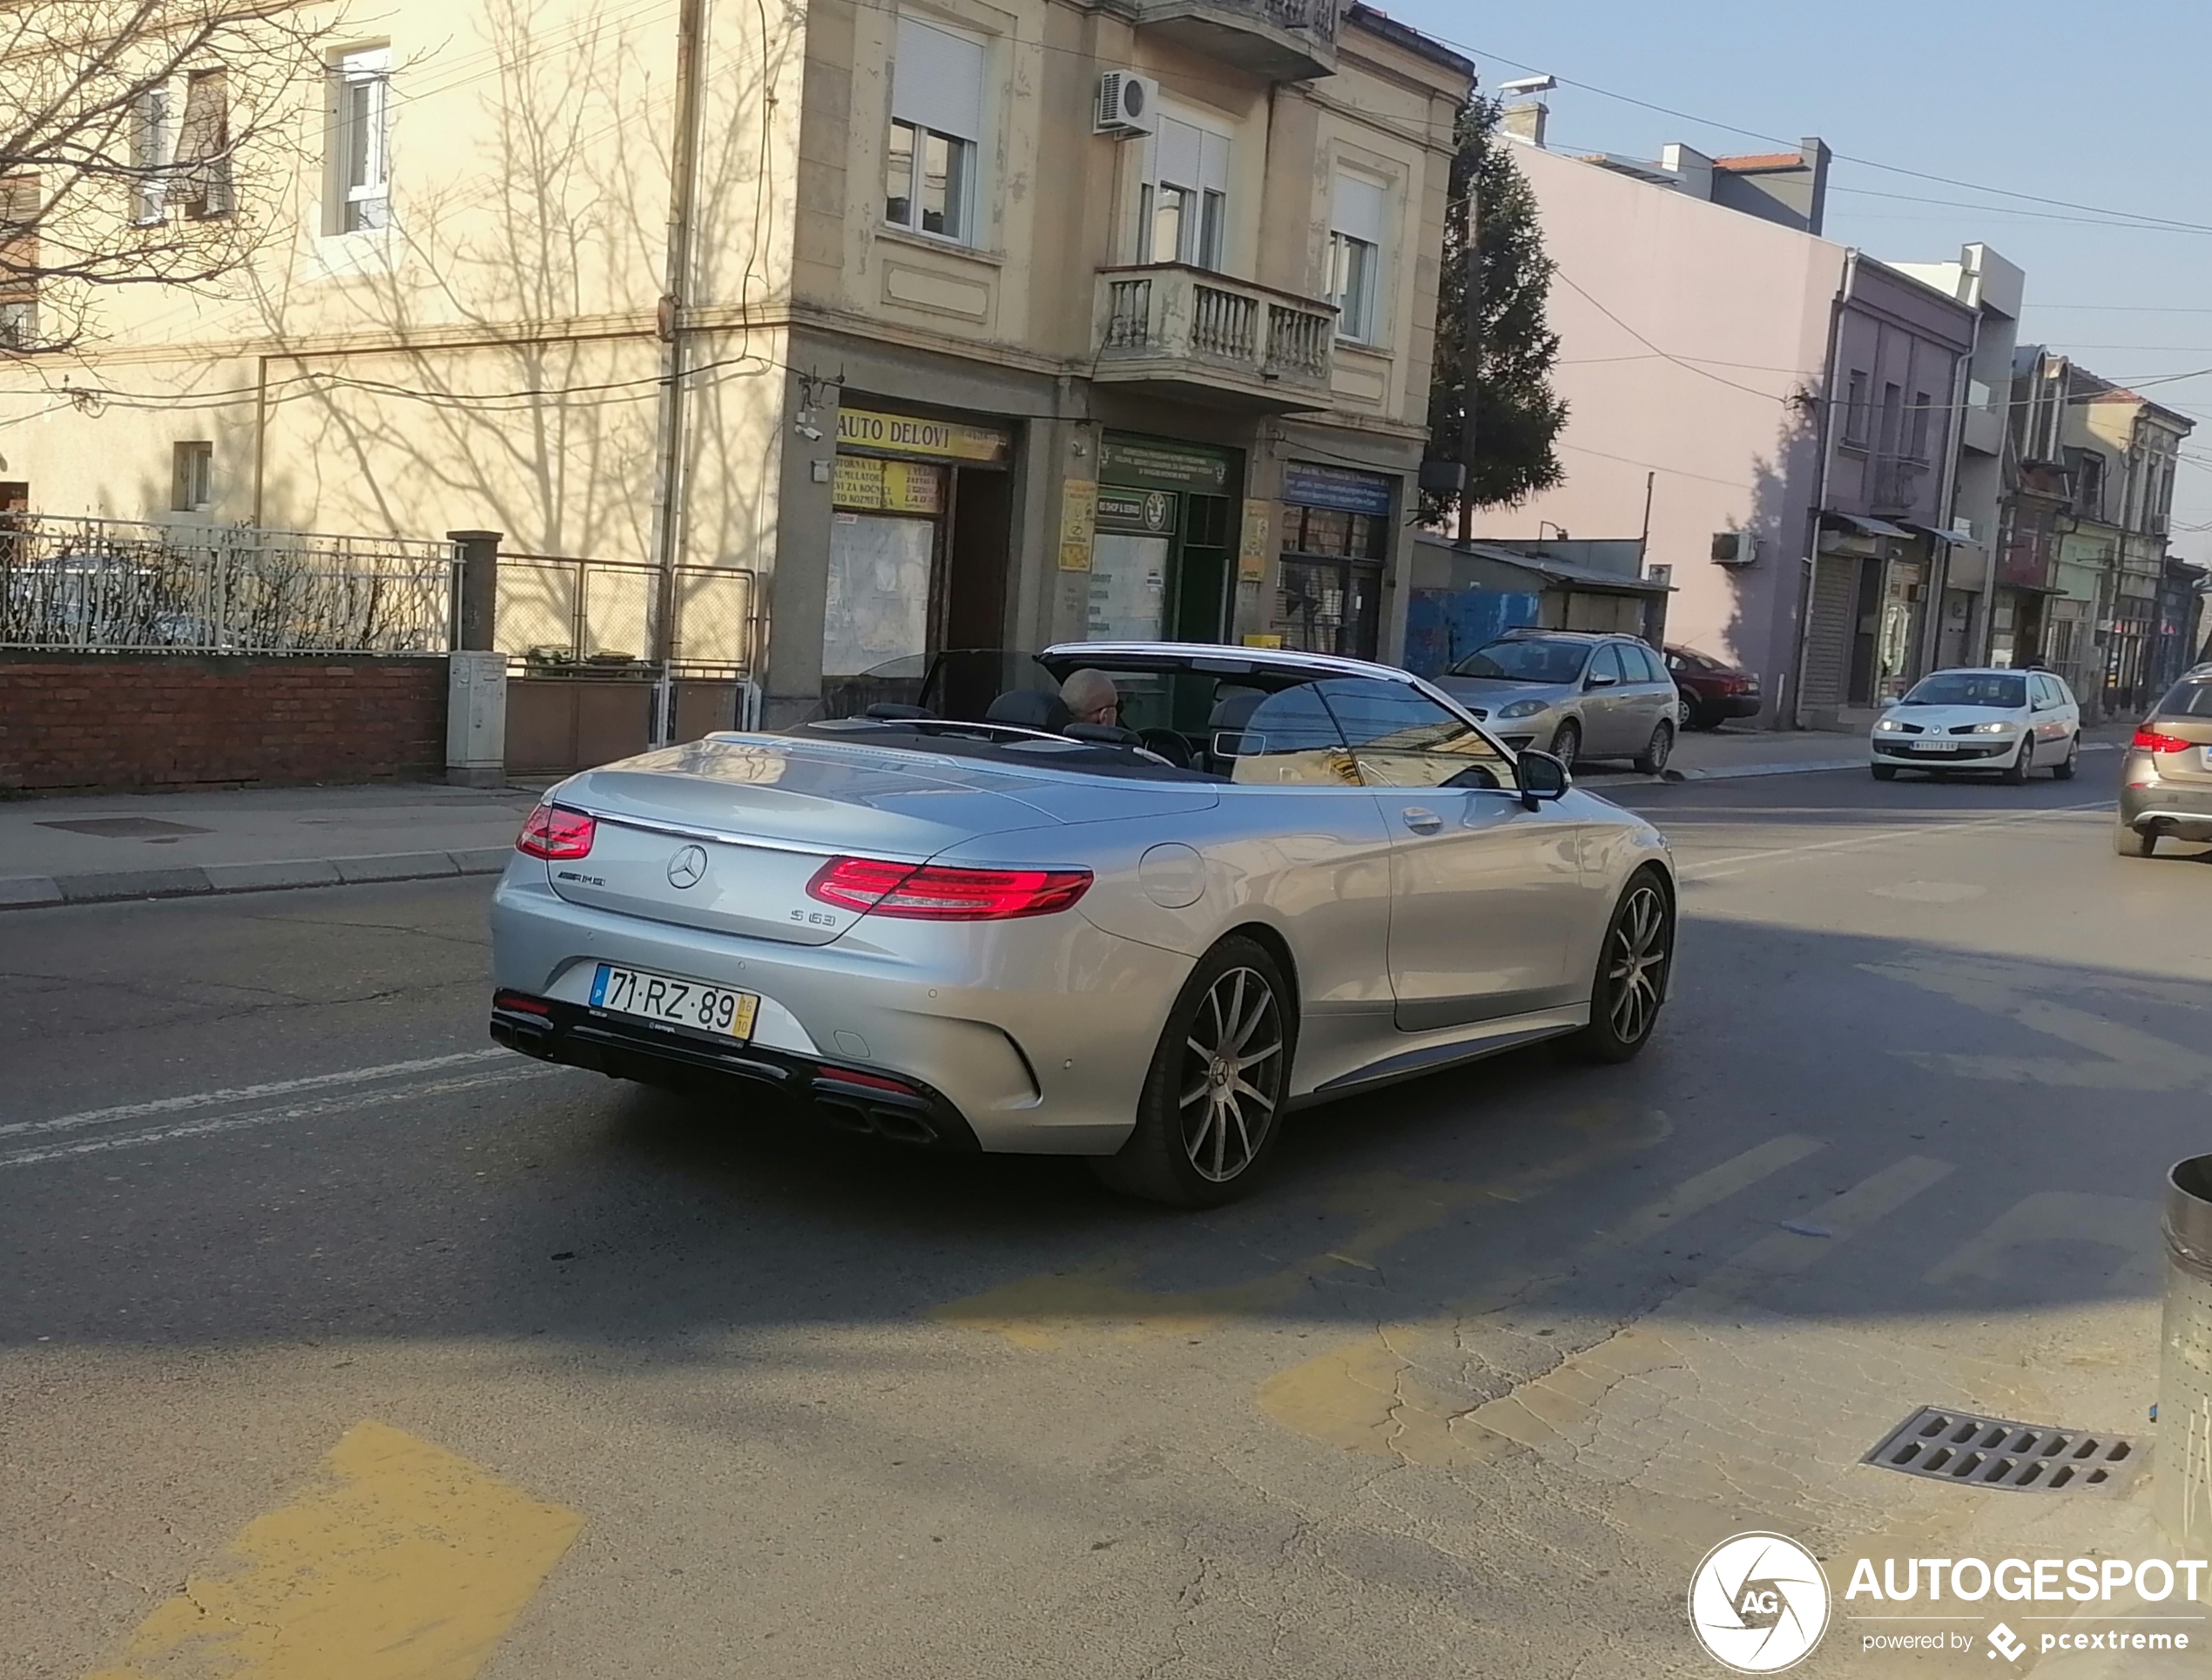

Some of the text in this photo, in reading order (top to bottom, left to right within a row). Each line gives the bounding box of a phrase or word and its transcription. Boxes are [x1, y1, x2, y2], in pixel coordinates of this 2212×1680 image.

[837, 415, 883, 441] AUTO
[890, 421, 949, 449] DELOVI
[790, 909, 836, 927] S 63
[594, 988, 602, 999] P
[741, 1000, 752, 1013] 16
[738, 1021, 748, 1033] 10
